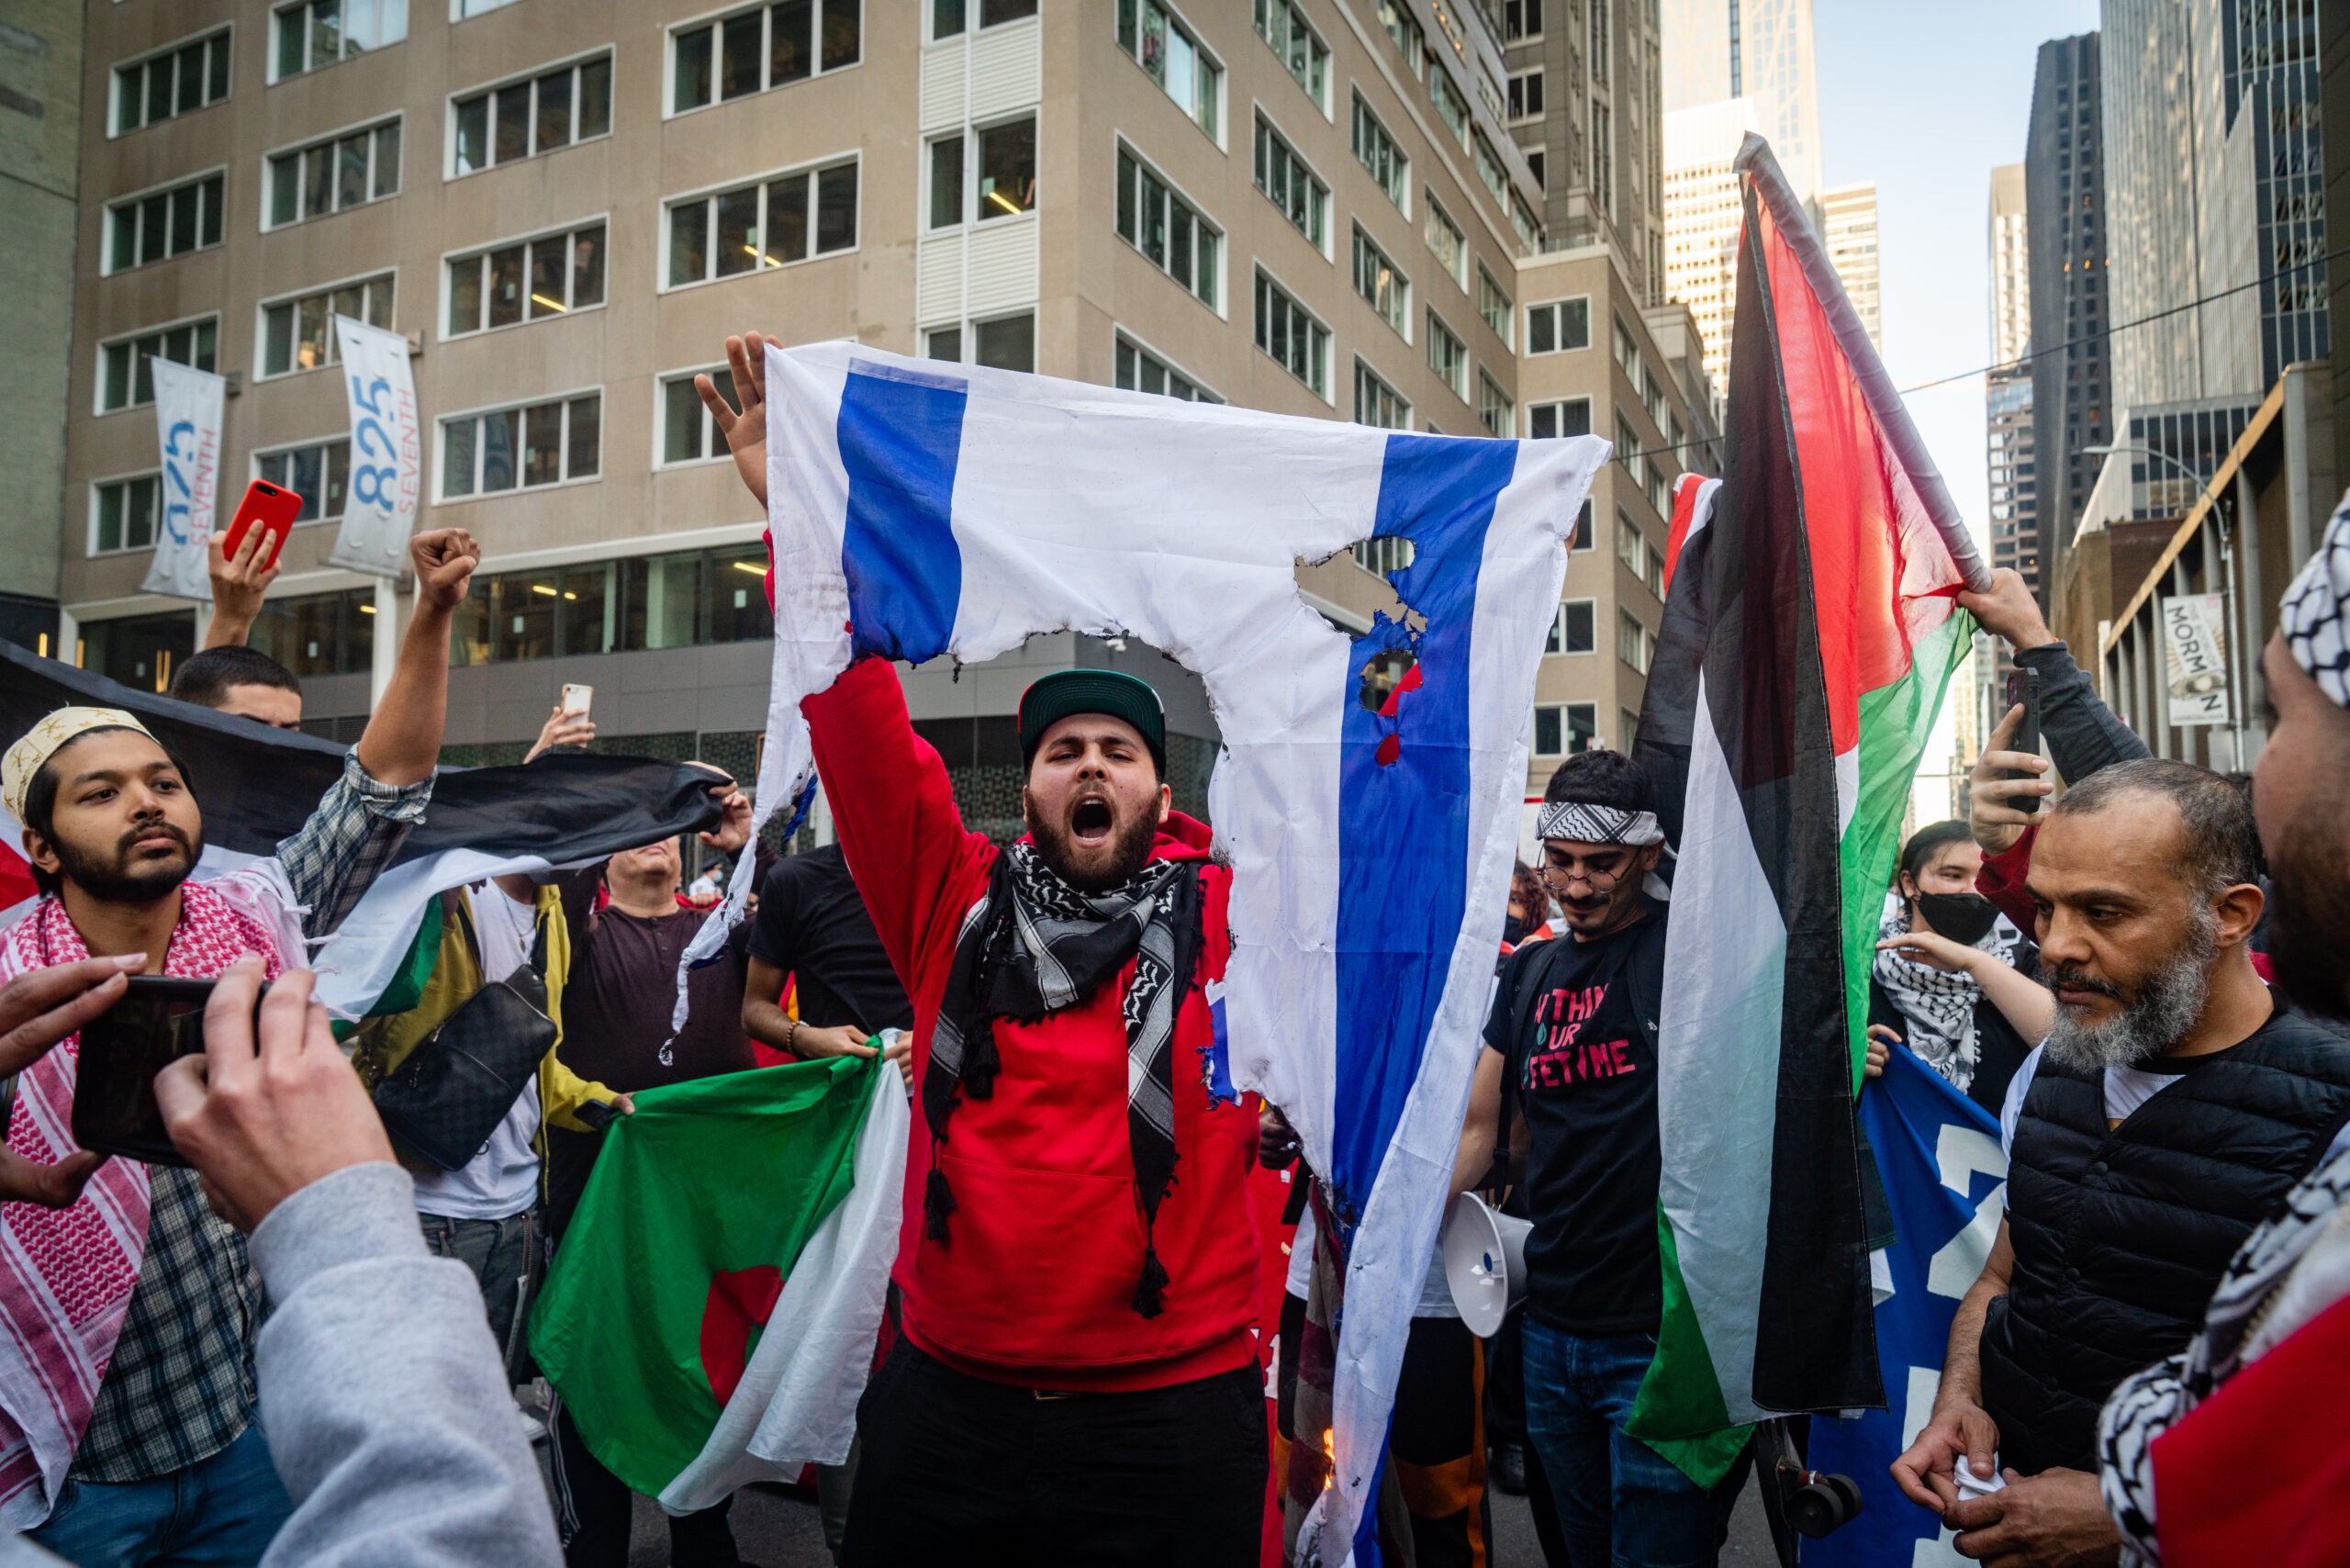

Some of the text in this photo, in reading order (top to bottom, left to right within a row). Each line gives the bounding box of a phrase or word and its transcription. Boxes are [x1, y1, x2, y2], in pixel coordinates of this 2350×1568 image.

[190, 428, 217, 546] SEVENTH
[352, 375, 397, 512] 825
[397, 387, 419, 515] SEVENTH
